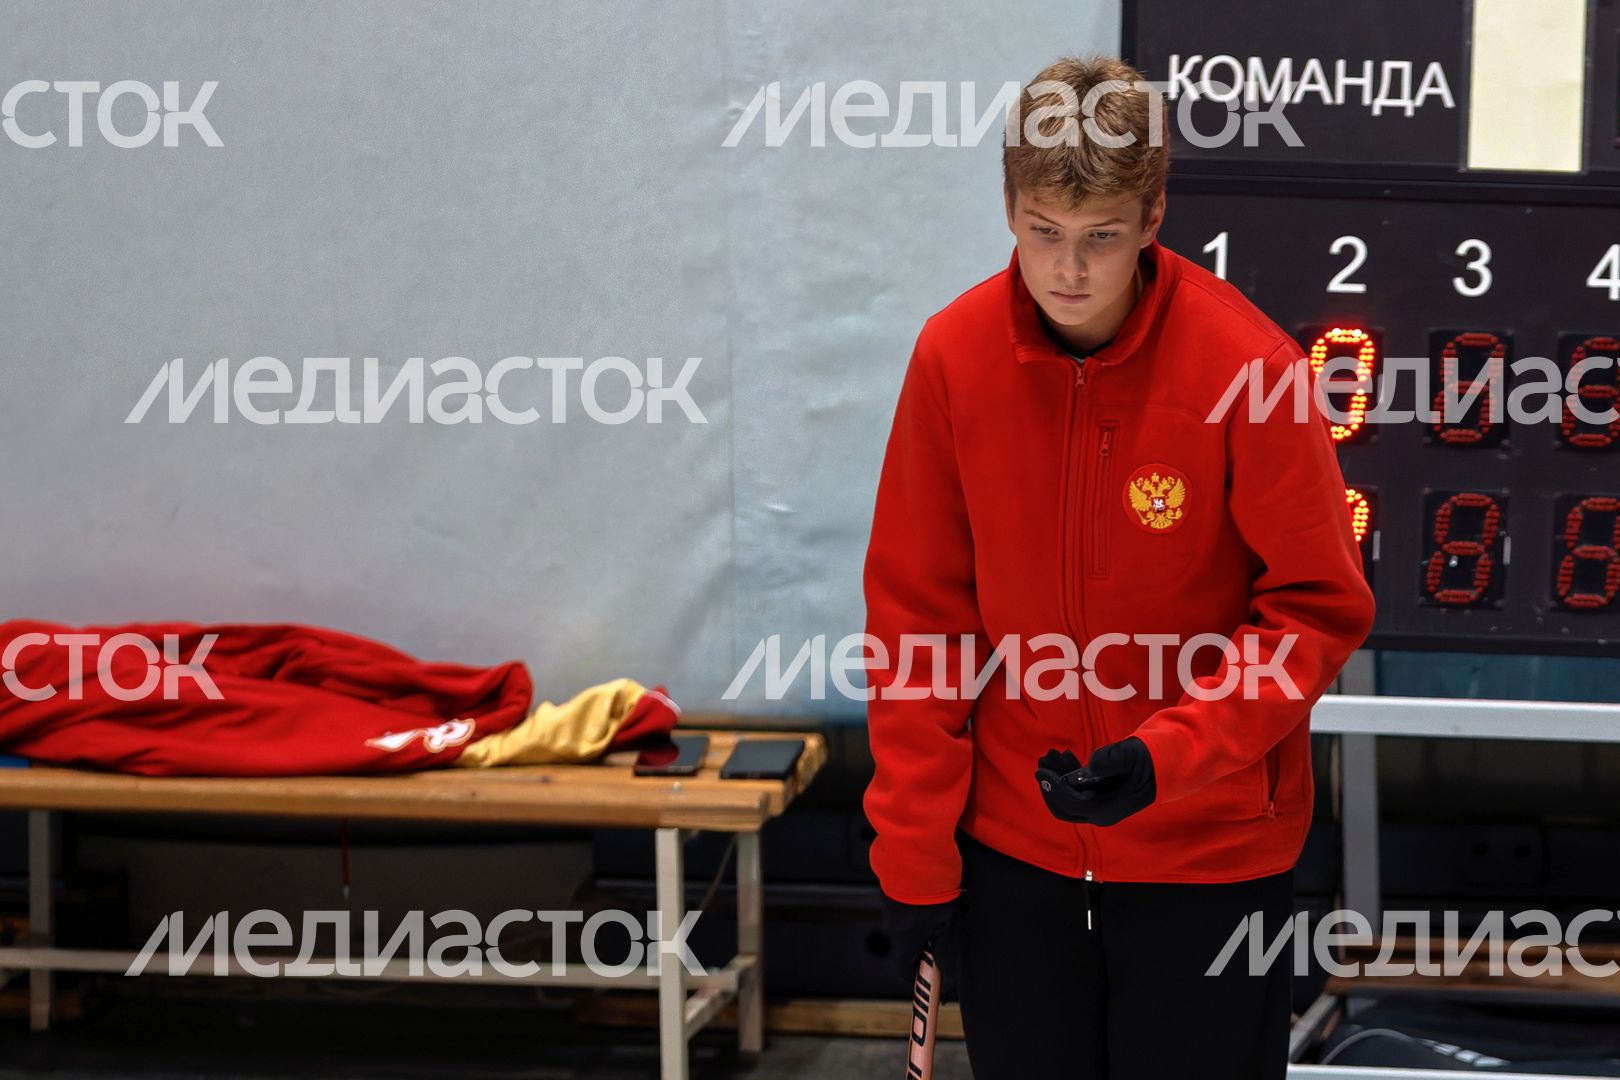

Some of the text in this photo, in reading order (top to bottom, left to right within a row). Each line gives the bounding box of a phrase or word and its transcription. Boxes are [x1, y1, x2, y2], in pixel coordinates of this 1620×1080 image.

[1166, 54, 1456, 116] КОМАНДА
[1327, 235, 1367, 294] 2
[1453, 238, 1493, 297] 3
